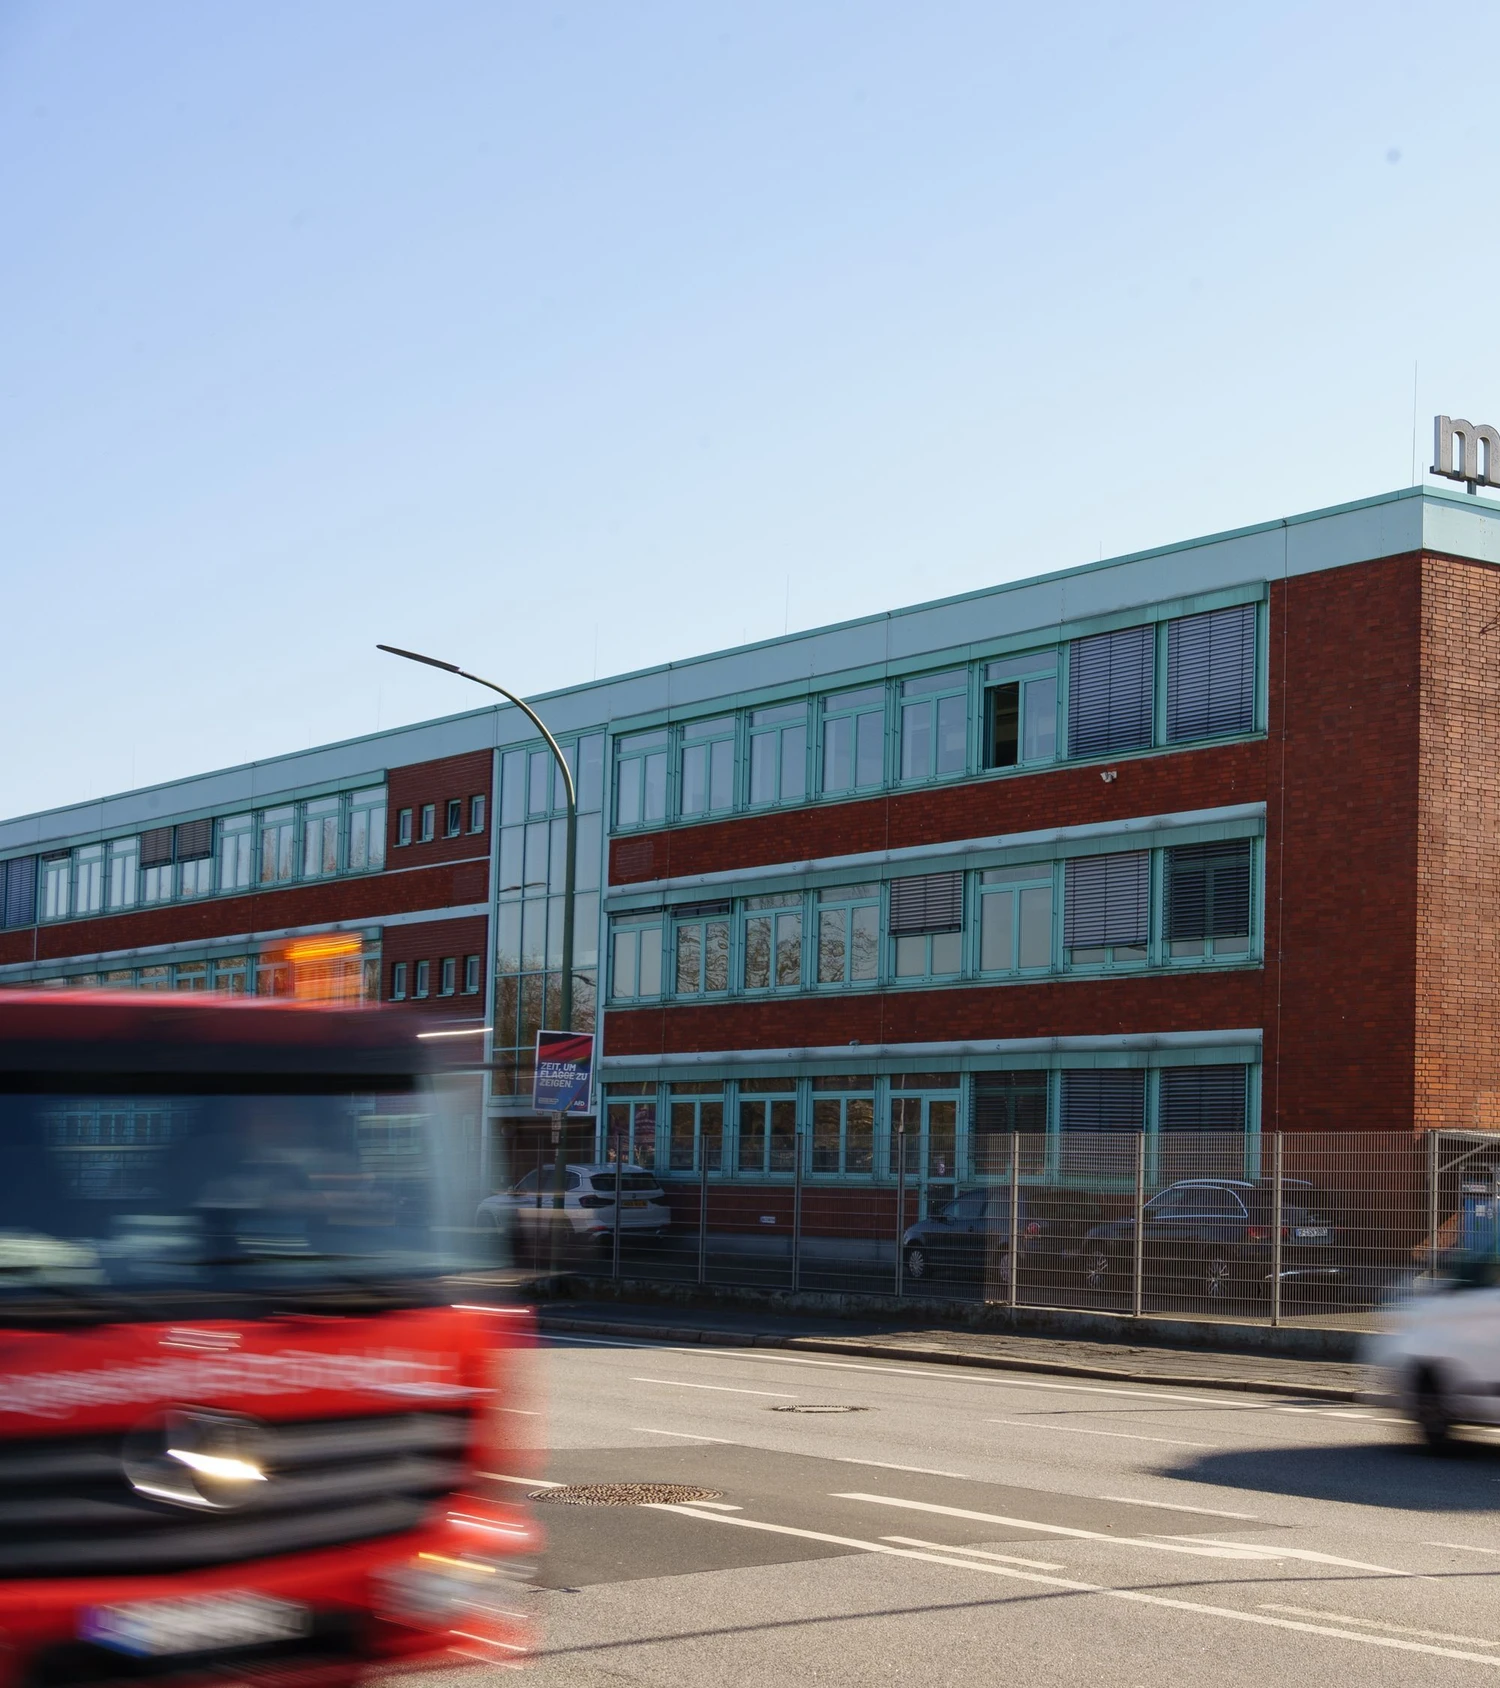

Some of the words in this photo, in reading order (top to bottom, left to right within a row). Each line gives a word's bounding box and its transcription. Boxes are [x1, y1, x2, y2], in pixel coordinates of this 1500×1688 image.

[540, 1061, 562, 1071] ZEIT,
[563, 1063, 577, 1071] UM
[540, 1070, 576, 1080] FLAGGE
[575, 1072, 588, 1081] ZU
[539, 1078, 574, 1089] ZEIGEN.
